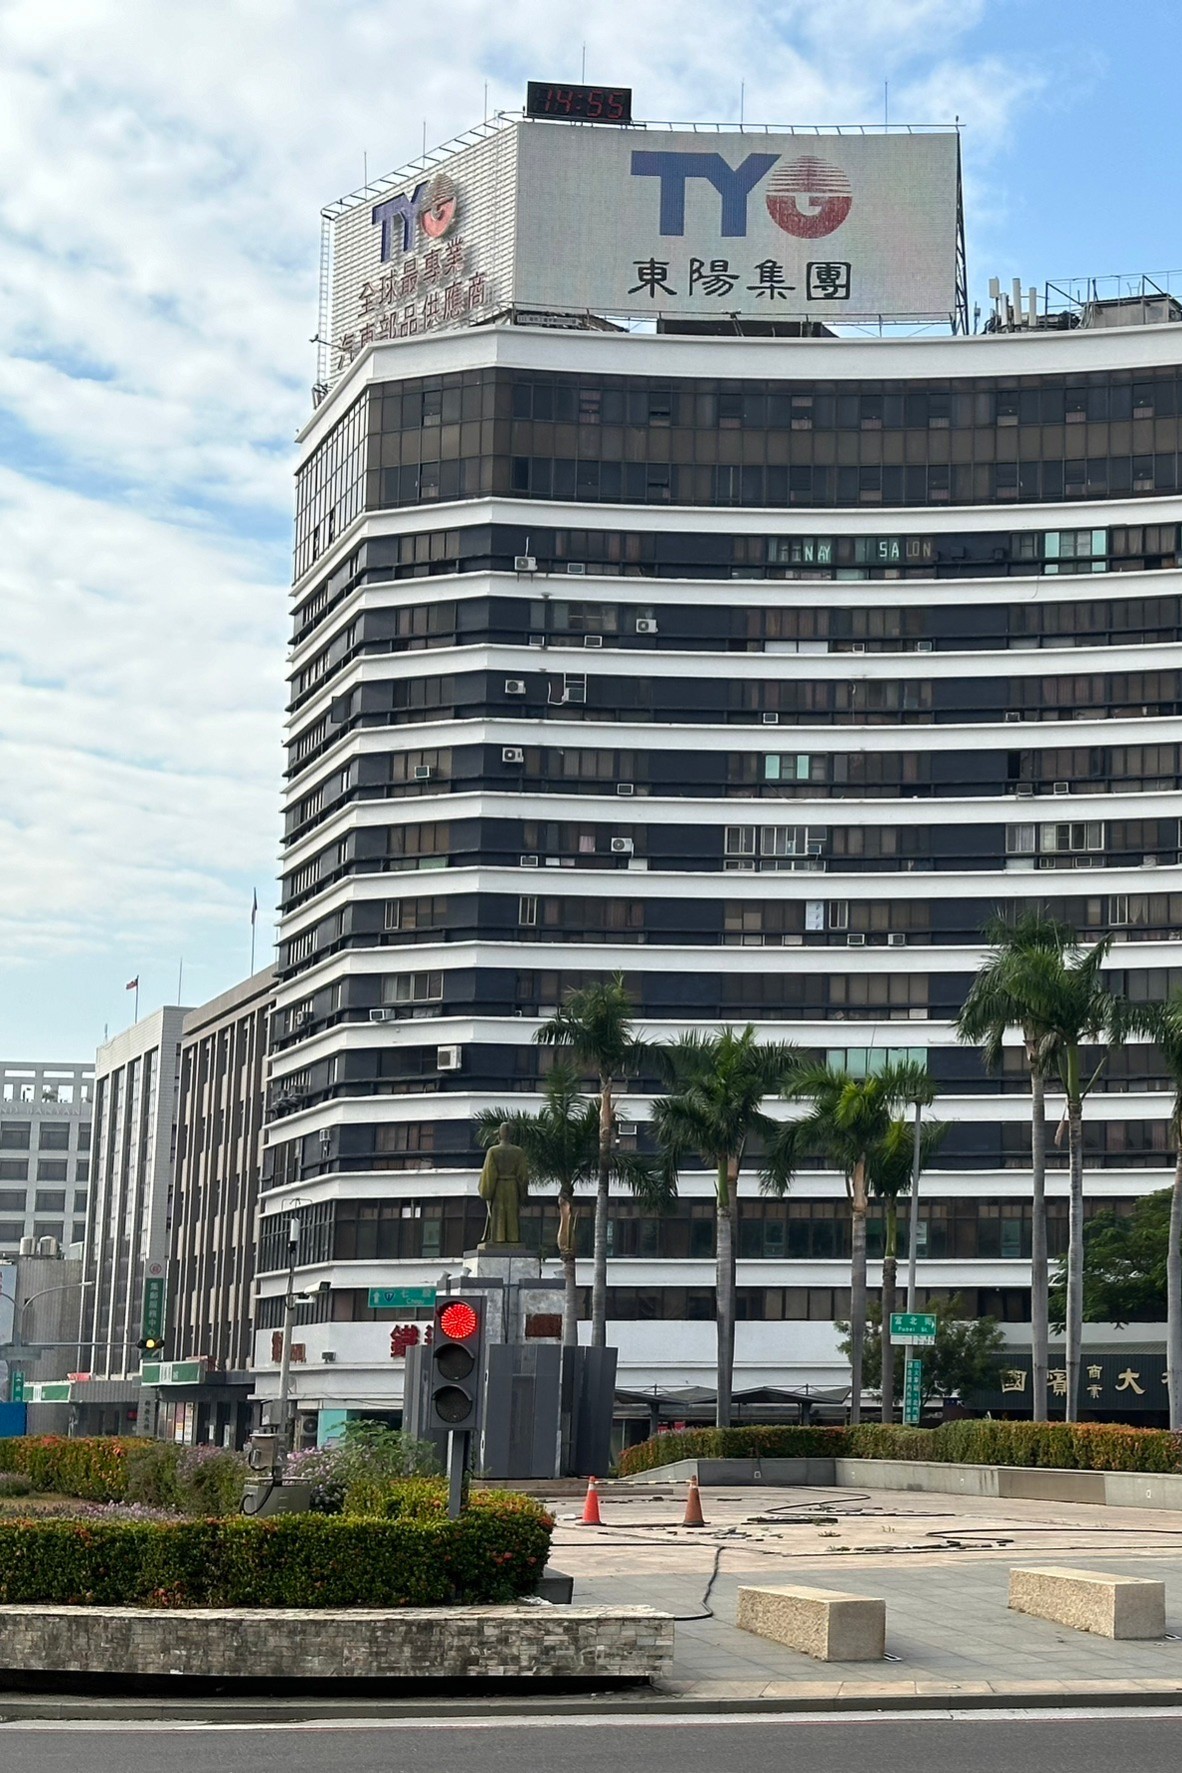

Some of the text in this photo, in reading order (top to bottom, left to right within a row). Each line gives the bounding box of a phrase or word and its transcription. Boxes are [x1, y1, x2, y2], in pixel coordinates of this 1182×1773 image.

[544, 88, 624, 119] 14:55
[358, 236, 465, 318] 全球最專業
[627, 257, 851, 300] 東陽集團
[879, 541, 931, 558] SALON
[894, 1316, 933, 1326] 富北街
[390, 1325, 433, 1359] 鐵
